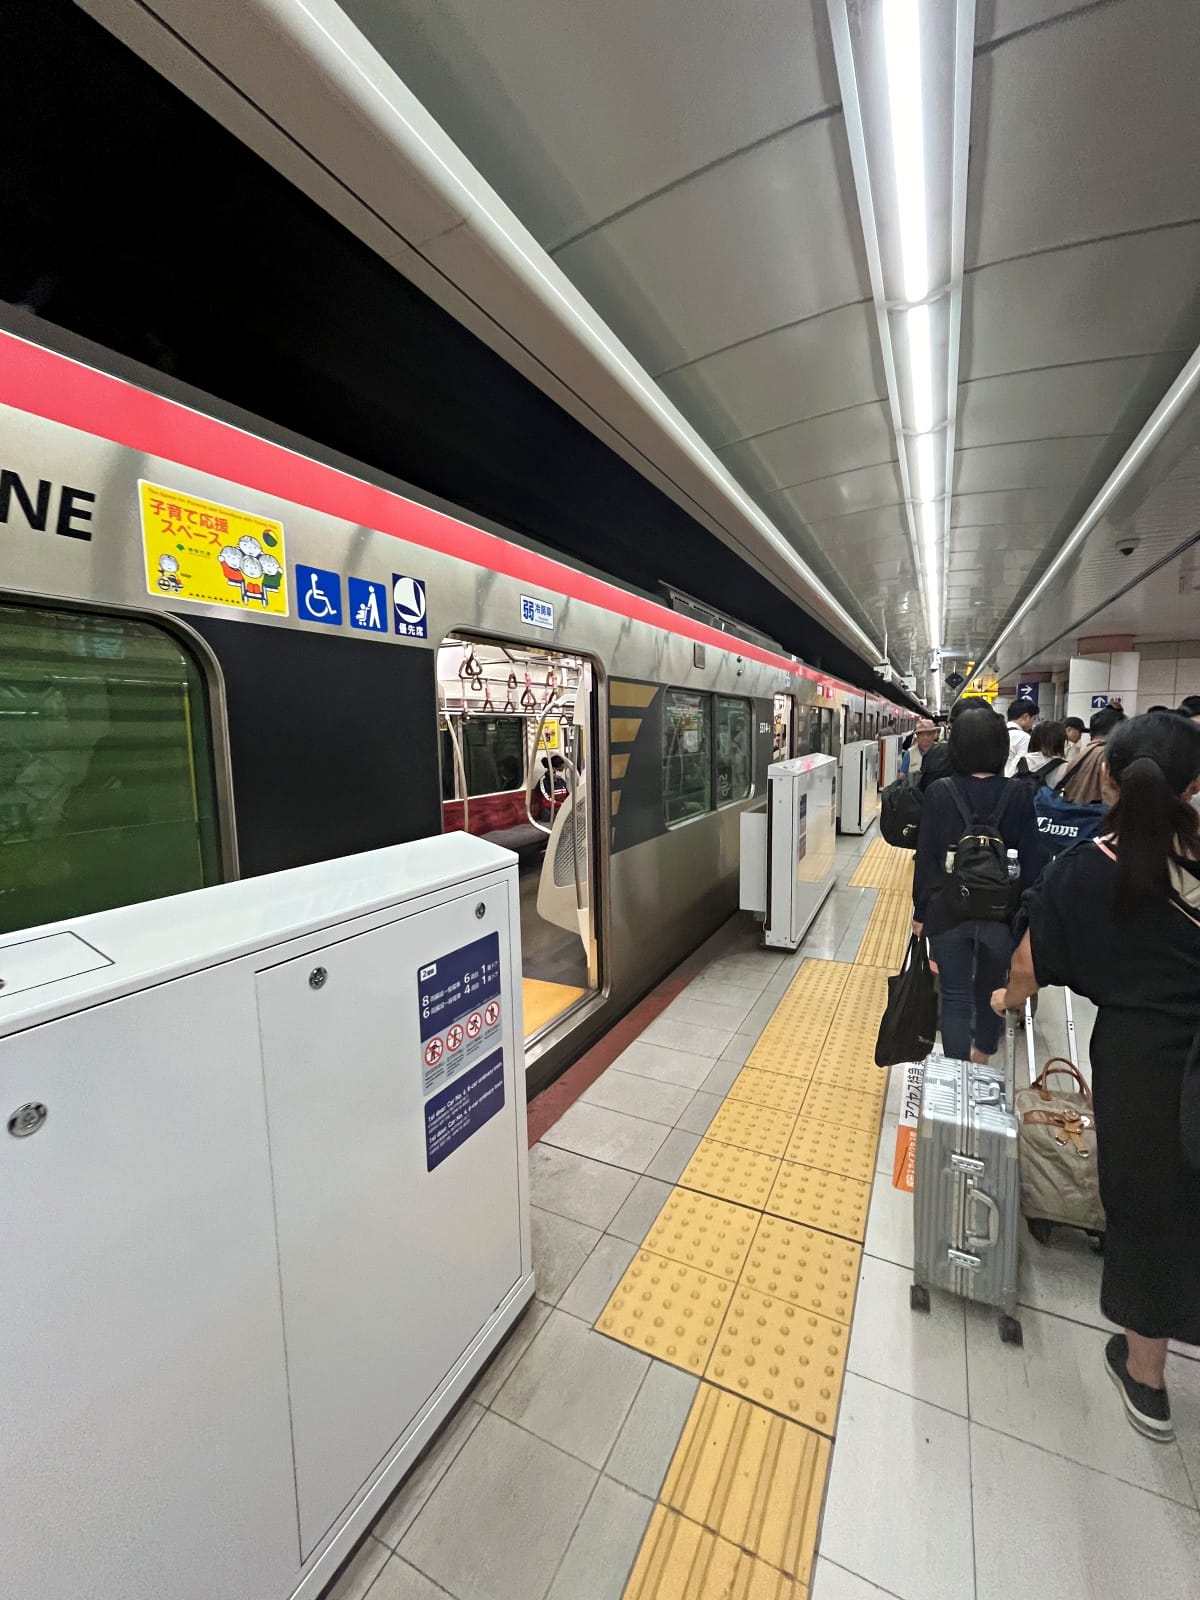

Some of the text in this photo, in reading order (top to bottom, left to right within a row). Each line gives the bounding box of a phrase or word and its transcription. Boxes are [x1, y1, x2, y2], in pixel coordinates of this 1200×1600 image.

[150, 498, 229, 534] 子育て応援
[161, 520, 222, 547] スペース
[1036, 816, 1079, 838] Lions
